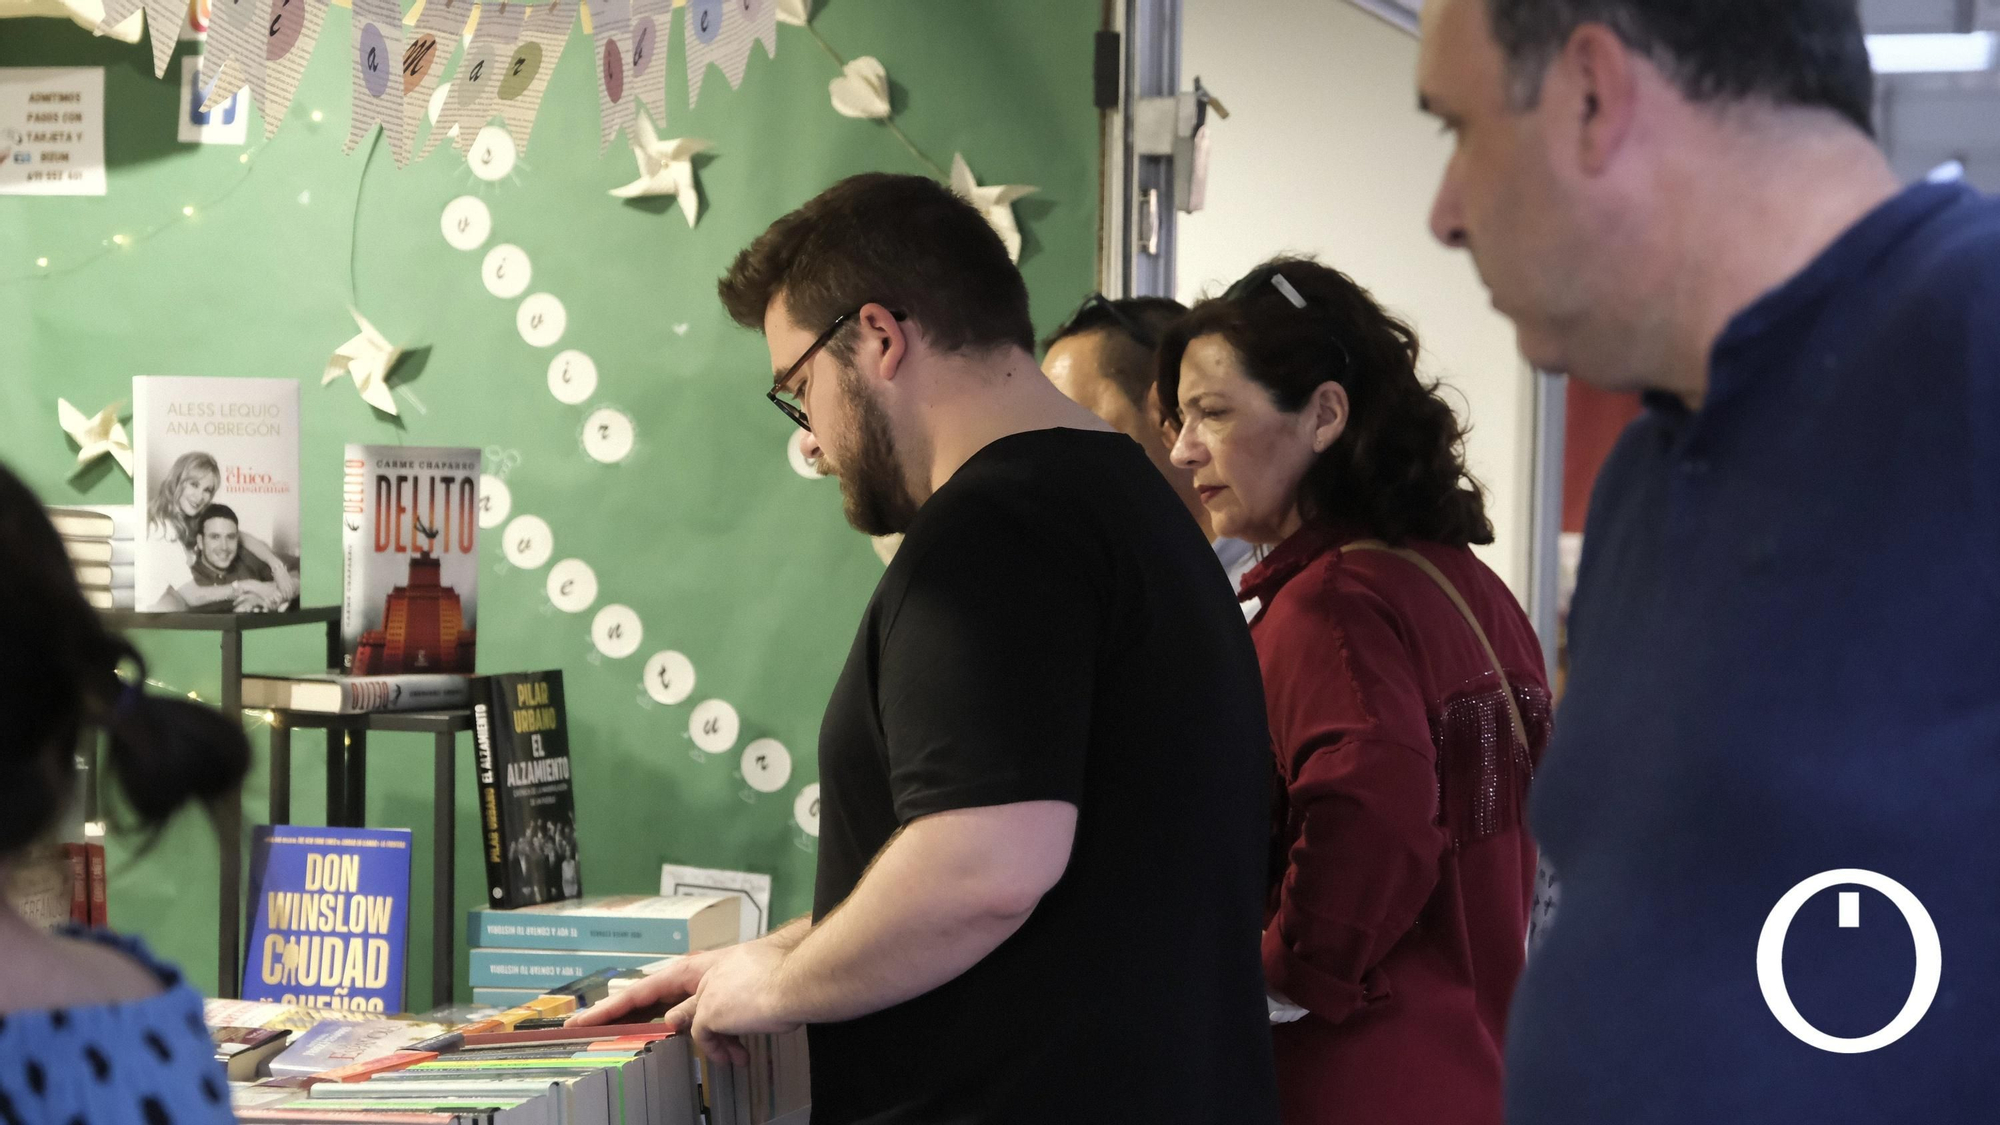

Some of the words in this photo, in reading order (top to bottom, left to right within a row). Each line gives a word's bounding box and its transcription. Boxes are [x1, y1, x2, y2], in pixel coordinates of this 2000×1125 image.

[26, 131, 72, 143] TARJETA
[167, 402, 216, 418] ALESS
[220, 403, 281, 418] LEQUIO
[165, 422, 200, 437] ANA
[203, 419, 281, 437] OBREGÓN
[376, 460, 415, 470] CARME
[418, 460, 476, 471] CHAPARRO
[225, 465, 272, 485] chico
[344, 459, 364, 514] DELITO
[374, 474, 475, 554] DELITO
[516, 681, 549, 707] PILAR
[512, 707, 557, 734] URBANO
[474, 703, 493, 770] ALZAMIENTO
[531, 733, 546, 758] EL
[481, 770, 494, 784] EL
[507, 756, 570, 787] ALZAMIENTO
[304, 852, 360, 893] DON
[267, 891, 394, 935] WINSLOW
[486, 924, 516, 936] HISTORIA
[517, 925, 525, 936] TU
[526, 925, 550, 937] CONTAR
[550, 926, 557, 937] A
[261, 933, 391, 990] CIUDAD
[489, 964, 519, 975] HISTORIA
[520, 965, 528, 976] TU
[529, 965, 554, 976] CONTAR
[554, 966, 561, 976] A
[561, 966, 573, 977] VOY
[574, 966, 583, 977] TE
